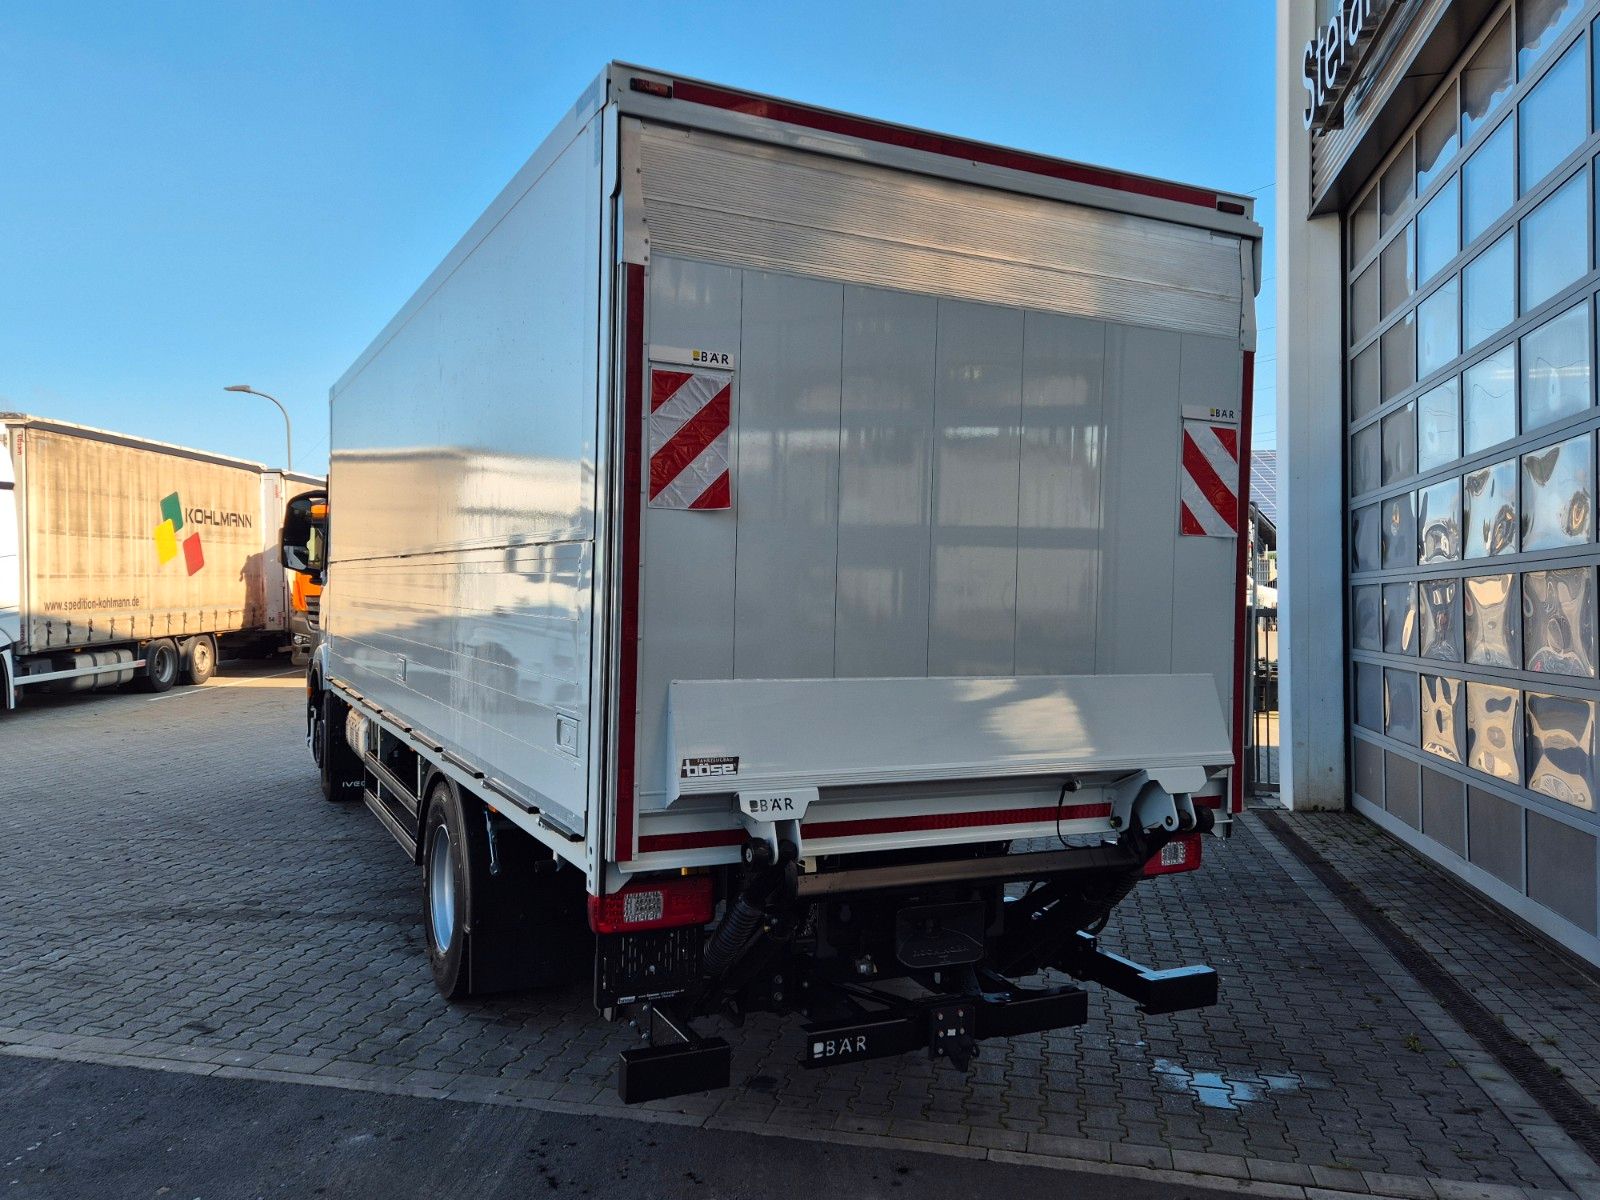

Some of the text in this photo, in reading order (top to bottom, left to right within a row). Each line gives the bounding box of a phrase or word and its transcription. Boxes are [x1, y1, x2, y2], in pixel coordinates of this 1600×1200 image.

[1302, 0, 1370, 131] Stefa
[701, 351, 729, 365] BÄR
[185, 507, 252, 528] KOHLMANN
[44, 595, 140, 611] www.spedition-kohlmann.de
[682, 759, 737, 776] böse
[760, 797, 794, 812] BÄR
[826, 1035, 866, 1056] BÄR
